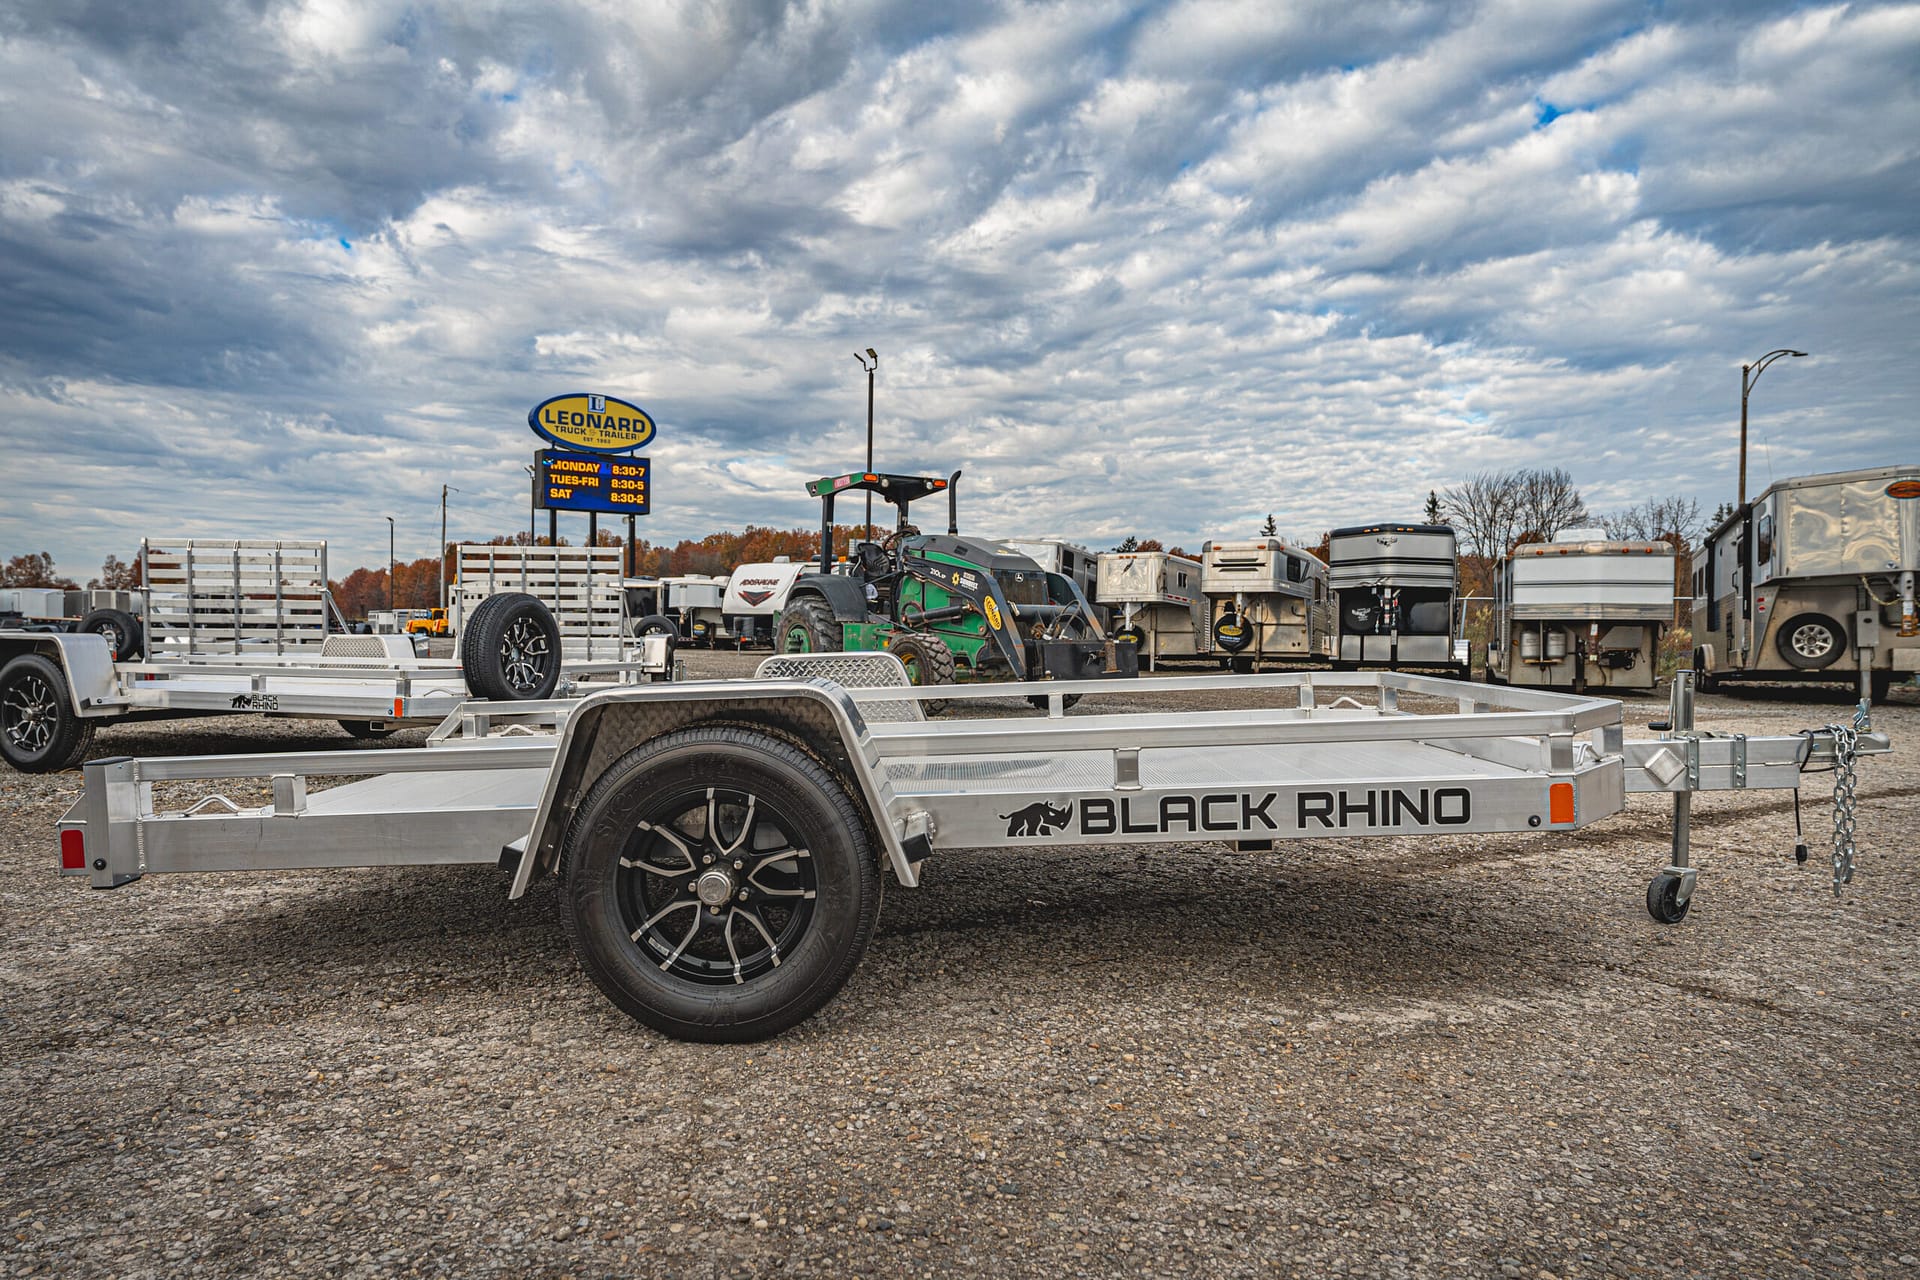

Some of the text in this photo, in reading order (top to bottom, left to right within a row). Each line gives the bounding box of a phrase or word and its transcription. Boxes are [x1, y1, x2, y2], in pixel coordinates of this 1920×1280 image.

[545, 409, 645, 433] LEONARD
[554, 425, 587, 435] TRUCK
[599, 430, 637, 440] TRAILER
[550, 460, 645, 477] MONDAY 8:30-7
[550, 474, 644, 490] TUES-FRI 8:30-5
[550, 488, 644, 504] SAT 8:30-2
[252, 701, 278, 710] RHINO
[1080, 788, 1471, 835] BLACK RHINO
